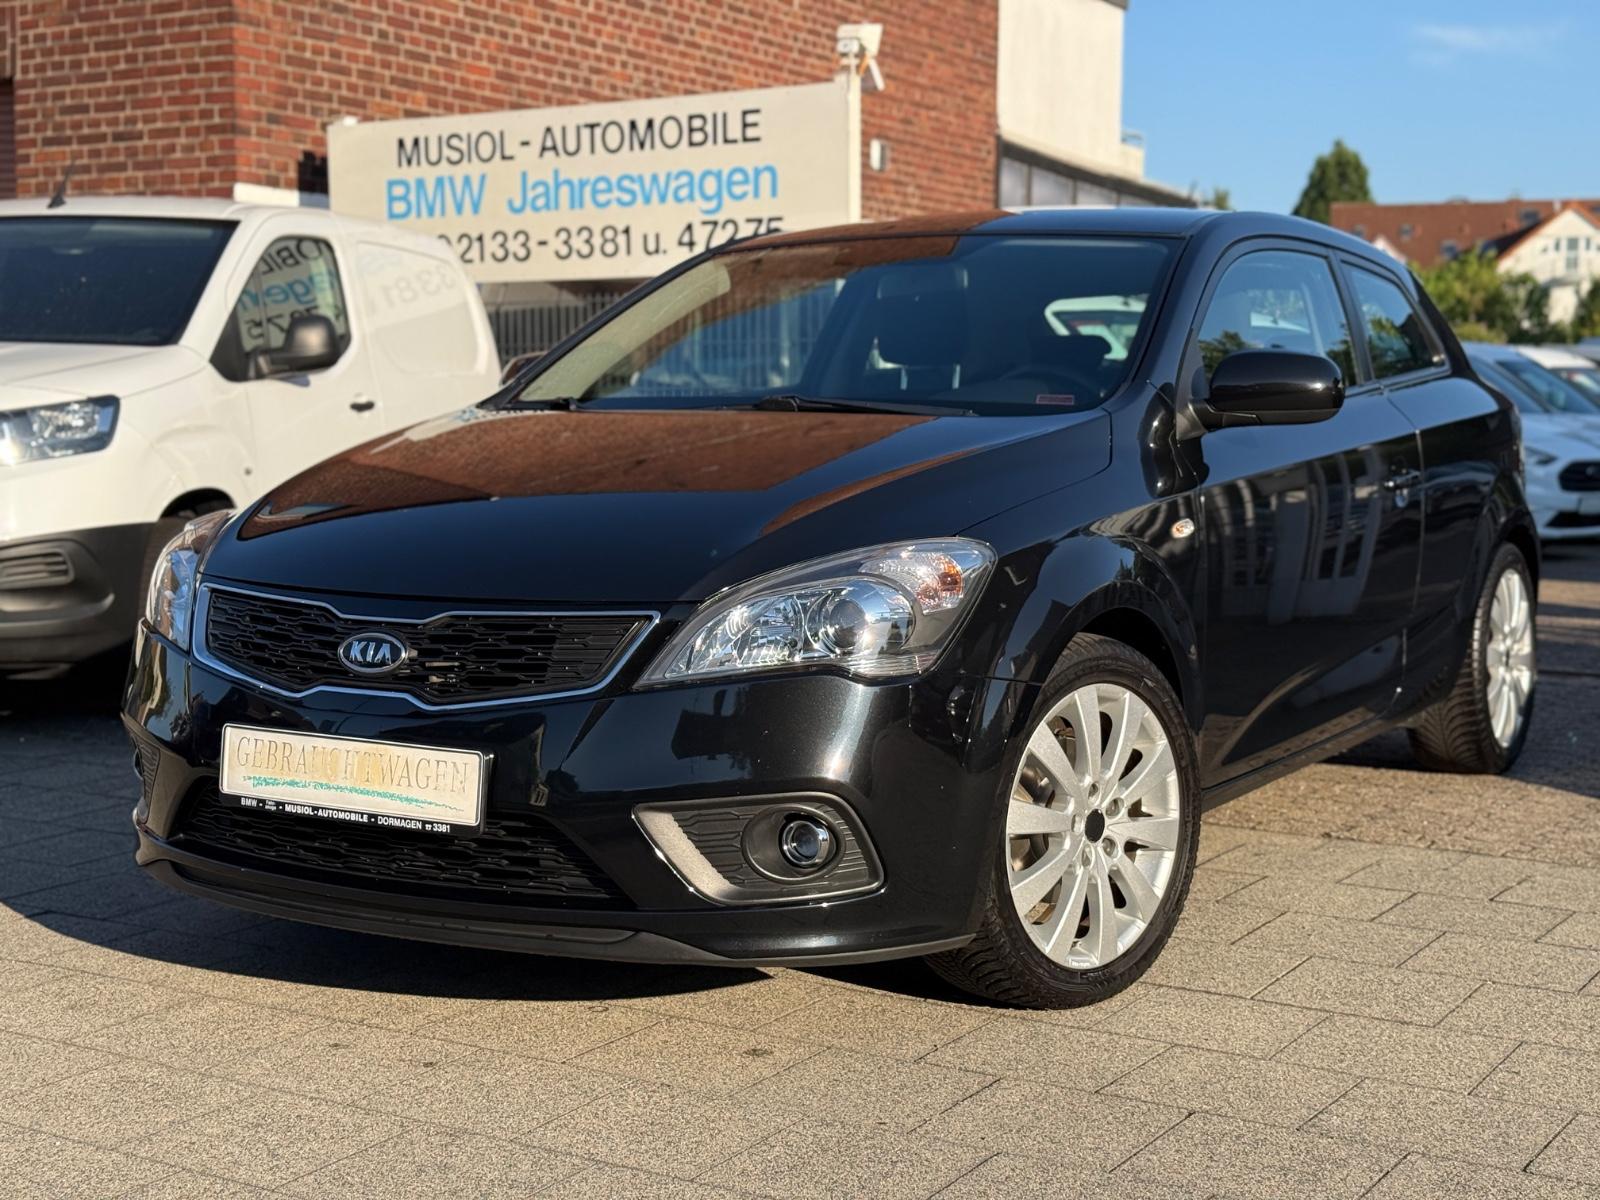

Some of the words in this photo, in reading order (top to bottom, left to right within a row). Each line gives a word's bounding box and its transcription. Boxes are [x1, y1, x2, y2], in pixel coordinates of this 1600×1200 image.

[386, 174, 488, 220] BMW
[506, 164, 778, 215] Jahreswagen
[643, 232, 667, 255] u.
[349, 640, 392, 665] KIA
[240, 797, 258, 808] BMW
[377, 815, 423, 830] DORMAGEN
[432, 823, 451, 833] 3381
